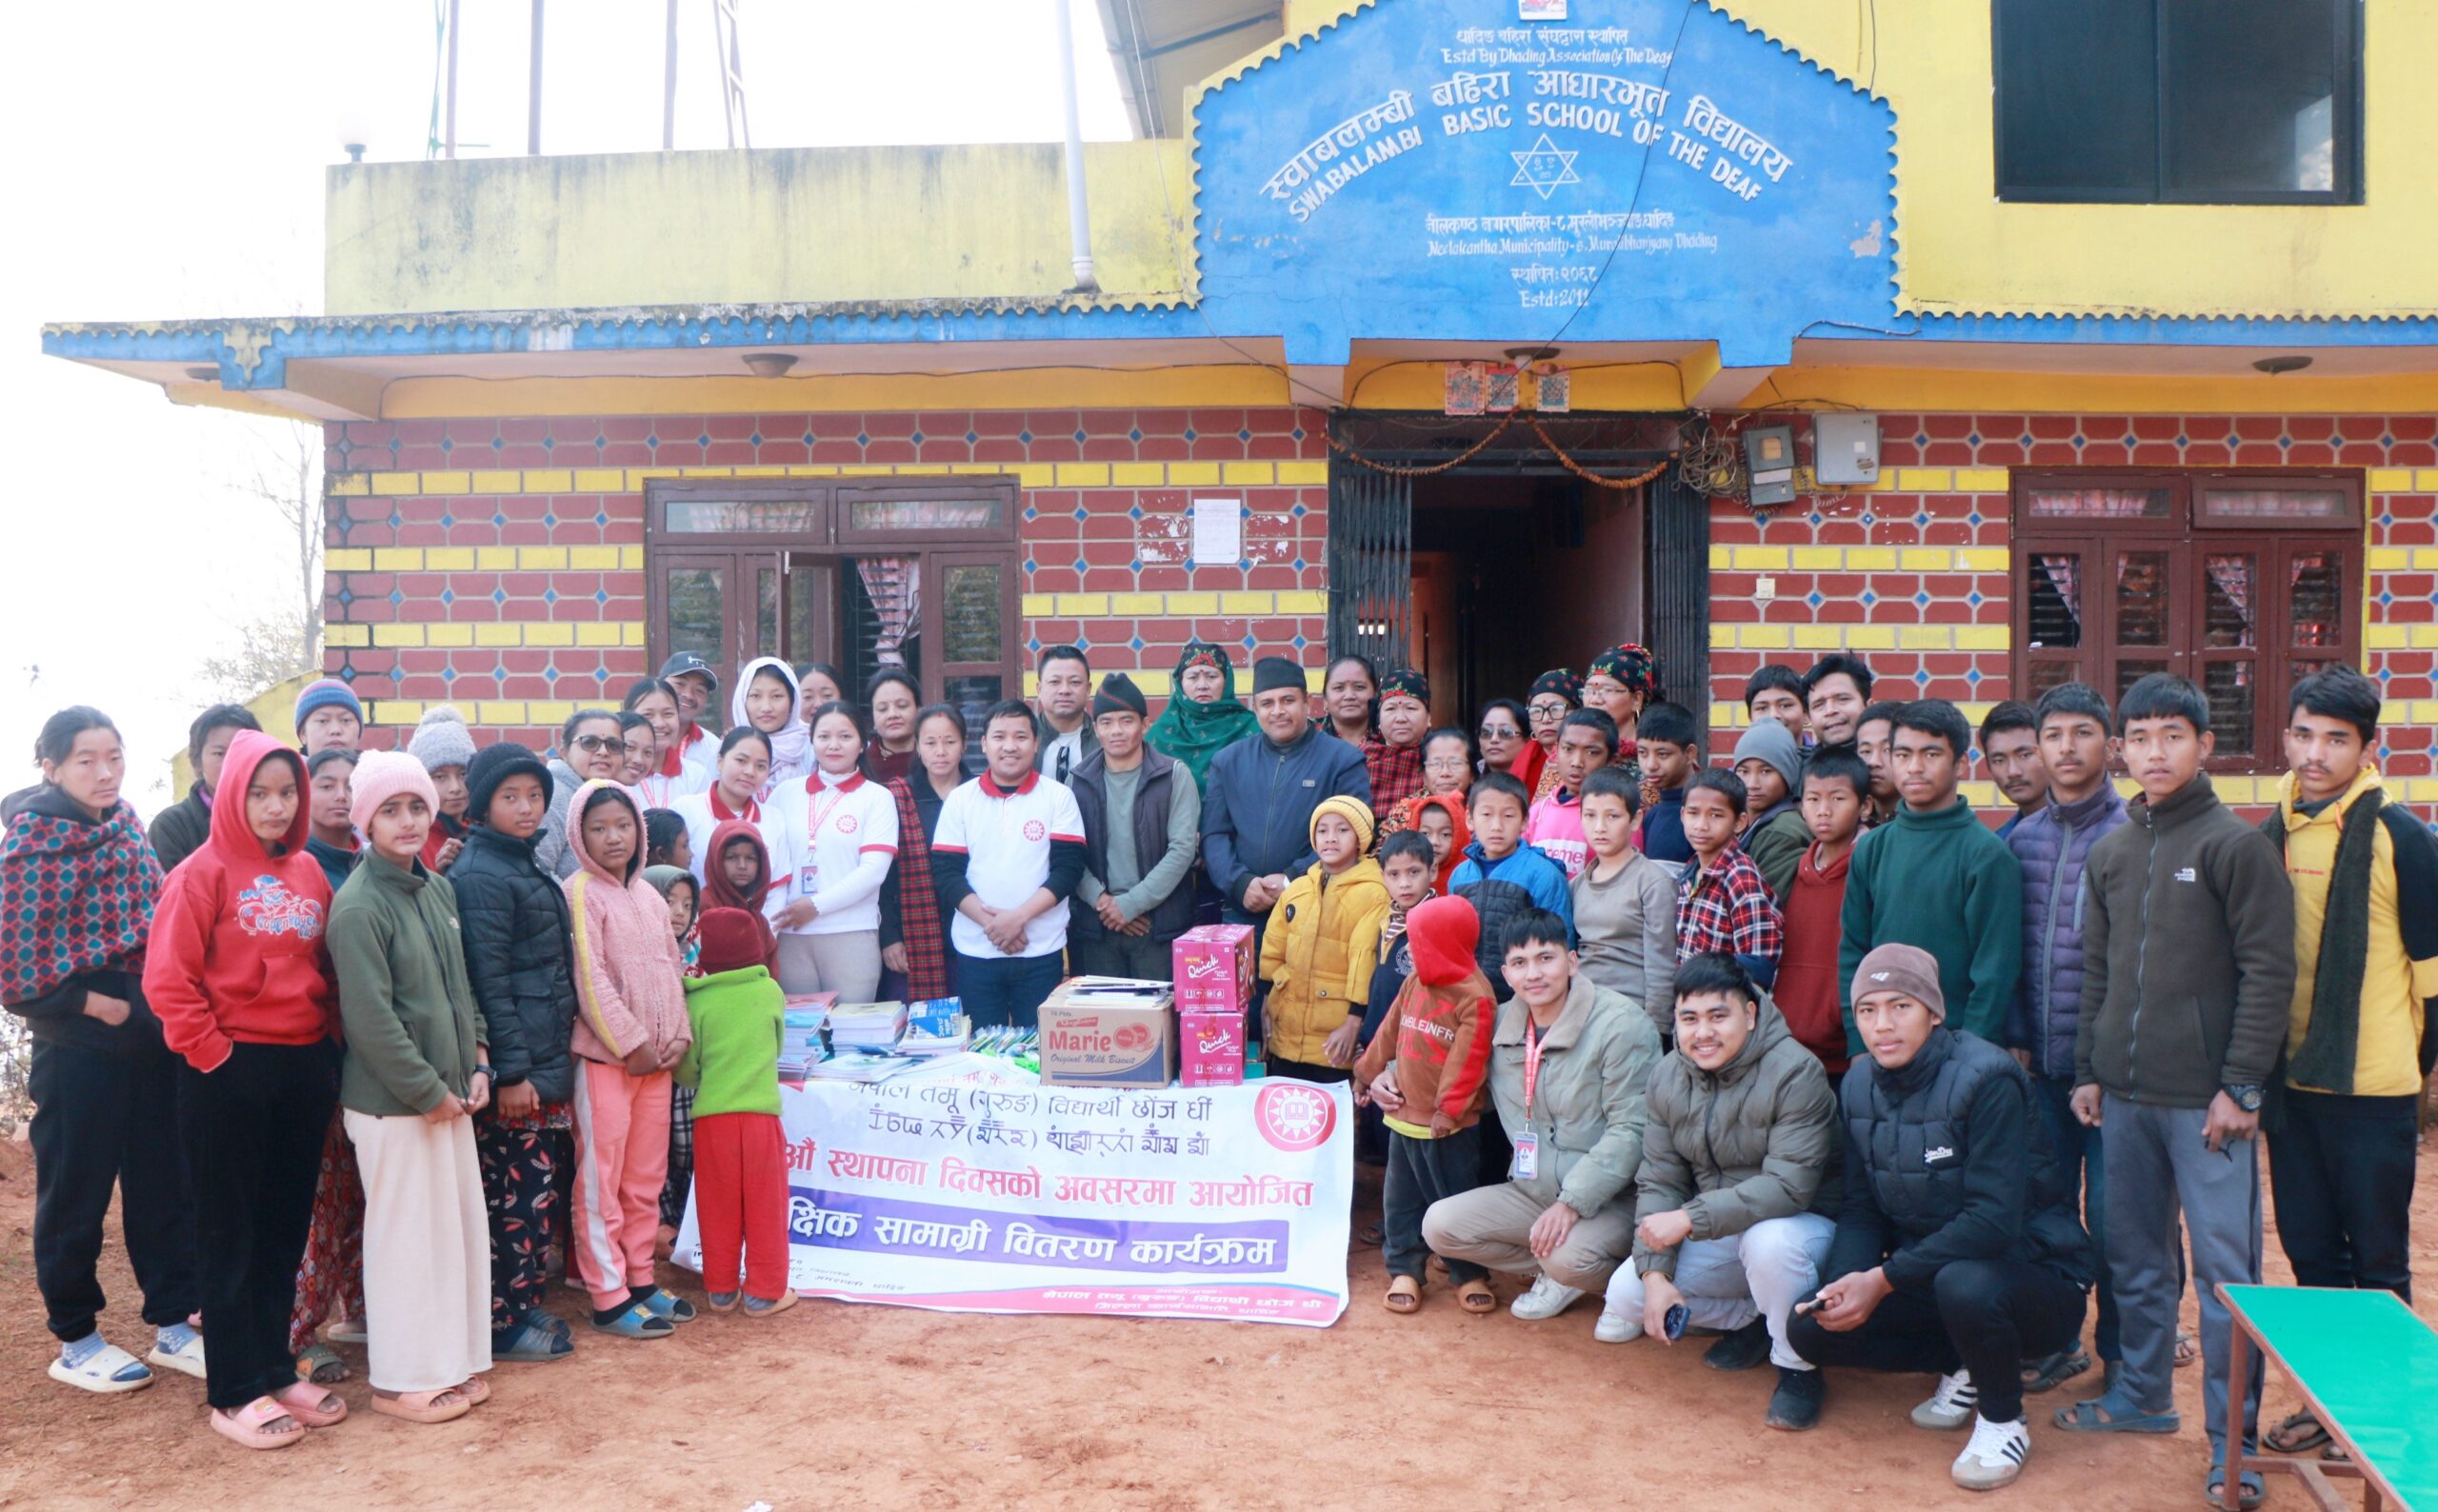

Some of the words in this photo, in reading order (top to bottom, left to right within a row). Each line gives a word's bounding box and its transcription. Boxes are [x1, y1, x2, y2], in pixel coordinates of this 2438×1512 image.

[1588, 26, 1629, 47] स्थापित
[1441, 48, 1475, 64] Estd
[1477, 48, 1497, 68] By
[1498, 48, 1545, 68] Dhading
[1623, 48, 1643, 64] The
[1430, 71, 1511, 107] बहिरा
[1527, 70, 1669, 119] आधारभूत
[1683, 94, 1793, 183] विद्यालय
[1289, 126, 1424, 223] SWABALAMBI
[1442, 105, 1511, 136] BASIC
[1527, 102, 1623, 137] SCHOOL
[1632, 119, 1664, 146] OF
[1668, 130, 1709, 170] THE
[1710, 157, 1762, 203] DEAF
[1188, 953, 1219, 979] Quick
[1049, 1030, 1111, 1052] Marie
[1199, 1029, 1231, 1054] Quick
[1050, 1053, 1082, 1064] Original
[1085, 1054, 1106, 1064] Milk
[1108, 1054, 1136, 1064] Biscuit
[920, 1086, 962, 1114] तमू
[1049, 1095, 1124, 1118] विद्यार्थी
[828, 1148, 929, 1186] स्थापना
[938, 1155, 1043, 1199] दिवसको
[1054, 1175, 1177, 1205] अवसरमा
[1189, 1174, 1314, 1207] आयोजित
[874, 1216, 991, 1253] सामाग्री
[1003, 1222, 1118, 1263] वितरण
[1129, 1233, 1277, 1265] कार्यक्रम
